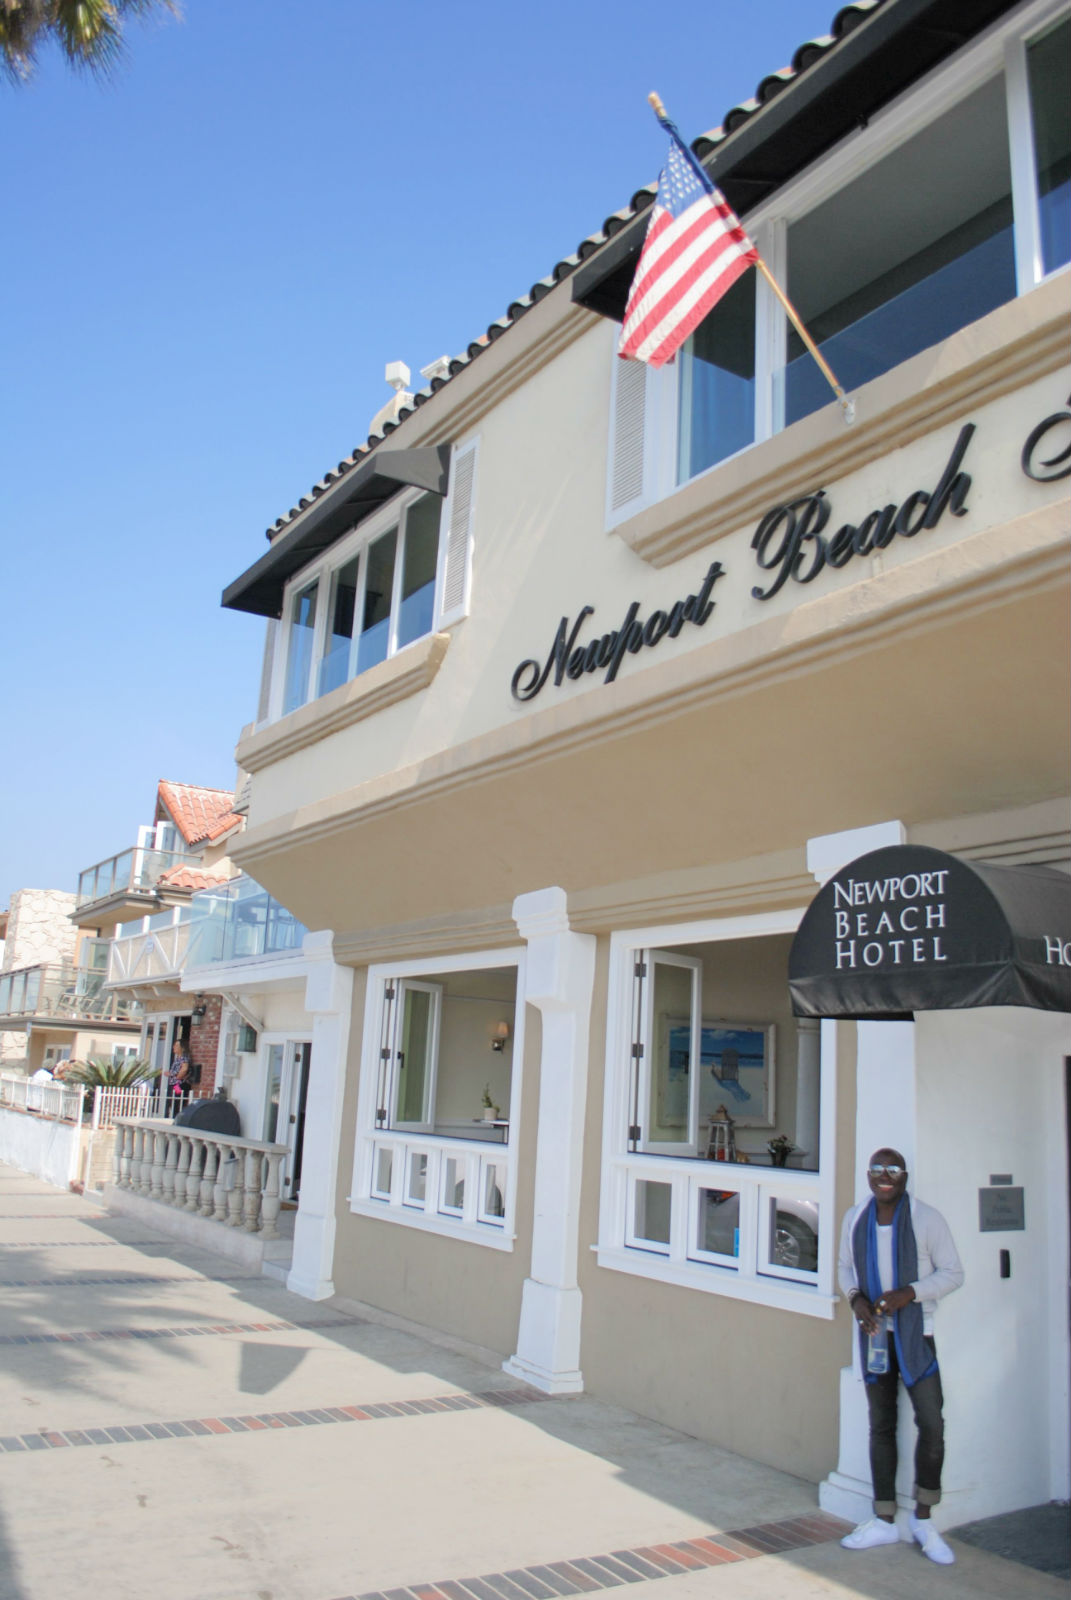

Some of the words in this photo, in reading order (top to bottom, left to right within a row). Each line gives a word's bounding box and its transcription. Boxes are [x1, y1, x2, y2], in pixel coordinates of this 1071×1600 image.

[511, 561, 726, 701] Newport
[751, 423, 976, 601] Beach
[833, 870, 949, 908] NEWPORT
[835, 904, 946, 939] BEACH
[835, 936, 948, 969] HOTEL
